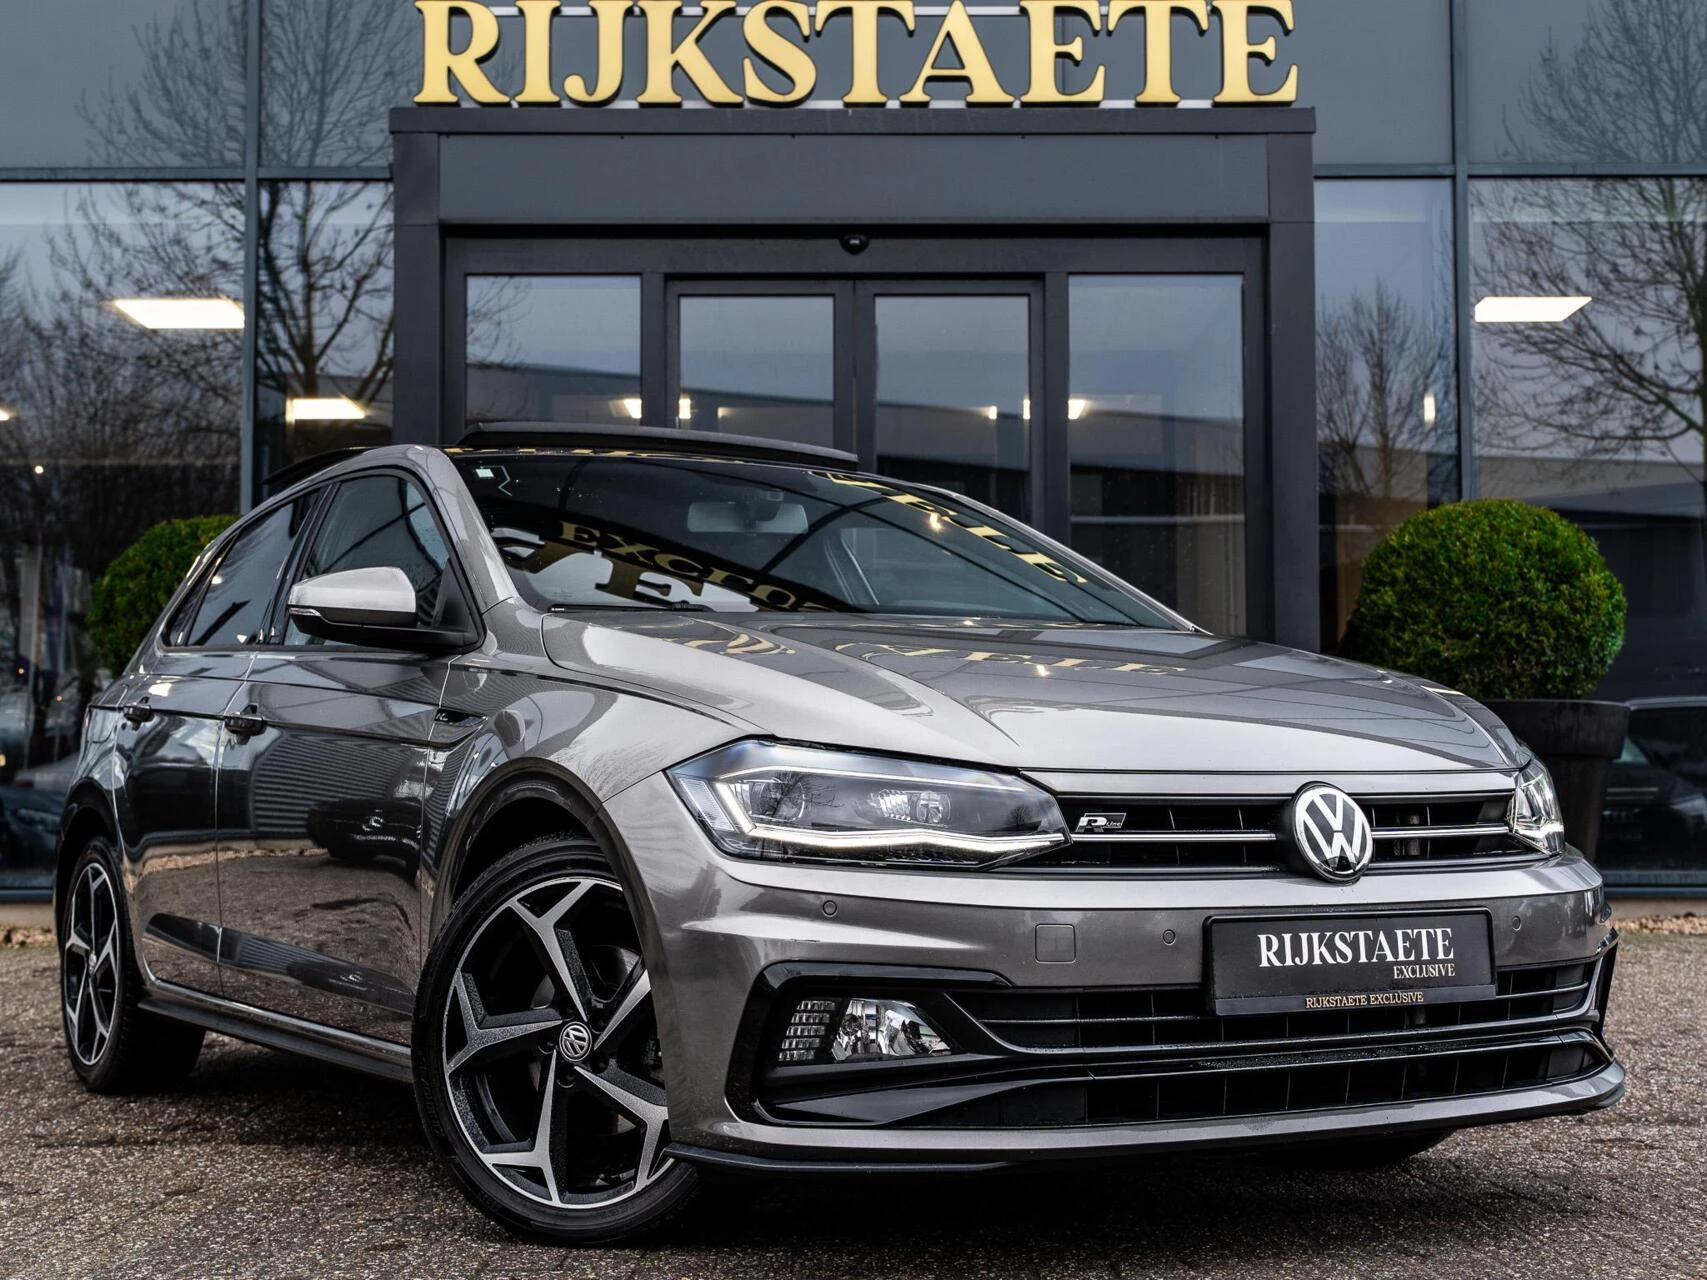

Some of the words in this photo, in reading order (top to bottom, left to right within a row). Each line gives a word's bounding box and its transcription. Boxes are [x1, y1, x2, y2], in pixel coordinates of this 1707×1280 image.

[413, 0, 1299, 104] RIJKSTAETE
[1257, 927, 1454, 968] RIJKSTAETE
[1393, 963, 1455, 979] EXCLUSIVE
[1305, 993, 1367, 1009] RIJKSTAETE
[1370, 991, 1424, 1006] EXCLUSIVE
